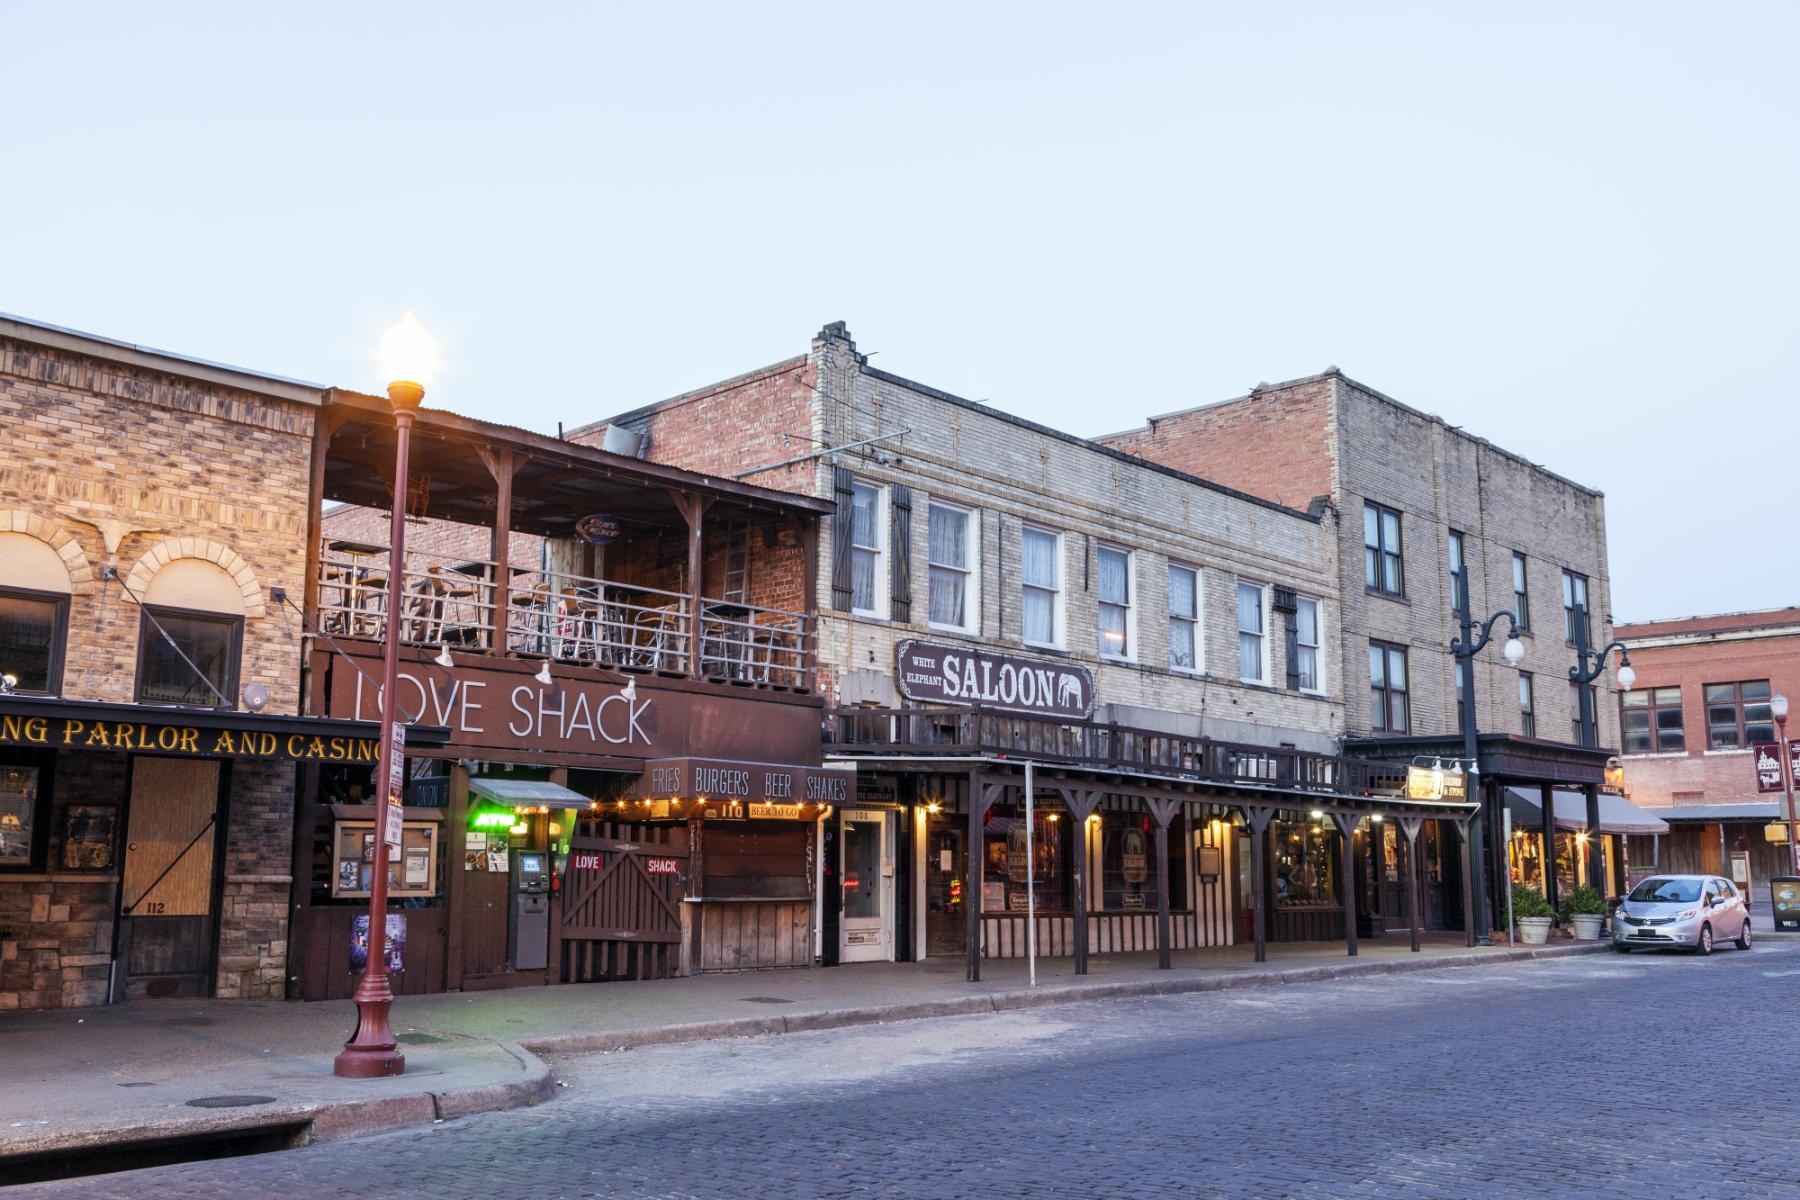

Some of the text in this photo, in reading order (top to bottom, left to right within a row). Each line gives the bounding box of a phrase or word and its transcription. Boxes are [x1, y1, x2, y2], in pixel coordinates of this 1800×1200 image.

[912, 656, 935, 669] WHITE
[906, 672, 942, 686] ELEPHANT
[942, 654, 1055, 707] SALOON
[509, 685, 651, 745] SHACK
[62, 719, 200, 752] PARLOR
[213, 730, 277, 755] AND
[652, 767, 680, 793] FRIES
[695, 768, 749, 796] BURGERS
[765, 772, 791, 797] BEER
[807, 776, 846, 800] SHAKES
[722, 804, 743, 818] 110
[751, 806, 797, 817] BEER TO GO
[575, 855, 599, 869] LOVE
[649, 860, 677, 872] SHACK
[147, 902, 165, 914] 112
